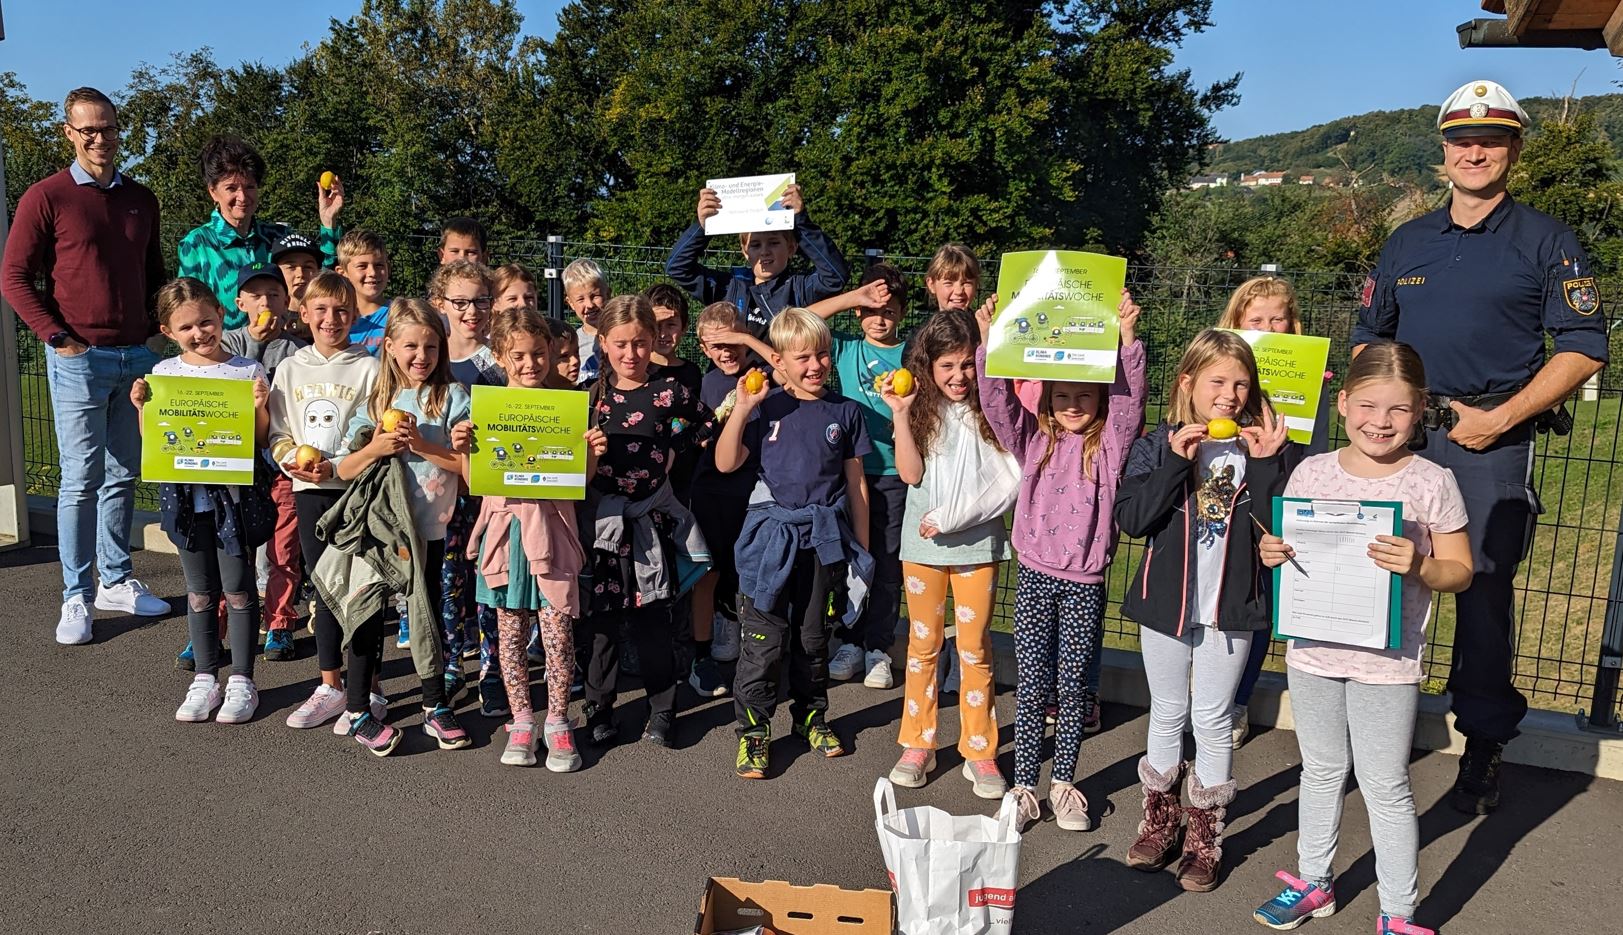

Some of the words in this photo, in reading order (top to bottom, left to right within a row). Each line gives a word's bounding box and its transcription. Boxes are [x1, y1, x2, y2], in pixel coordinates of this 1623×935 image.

[1255, 356, 1297, 368] OPÄISCHE
[170, 398, 229, 409] EUROPÄISCHE
[159, 408, 239, 419] MOBILITÄTSWOCHE
[499, 413, 561, 424] EUROPÄISCHE
[487, 423, 572, 435] MOBILITÄTSWOCHE
[975, 893, 1007, 904] jugend
